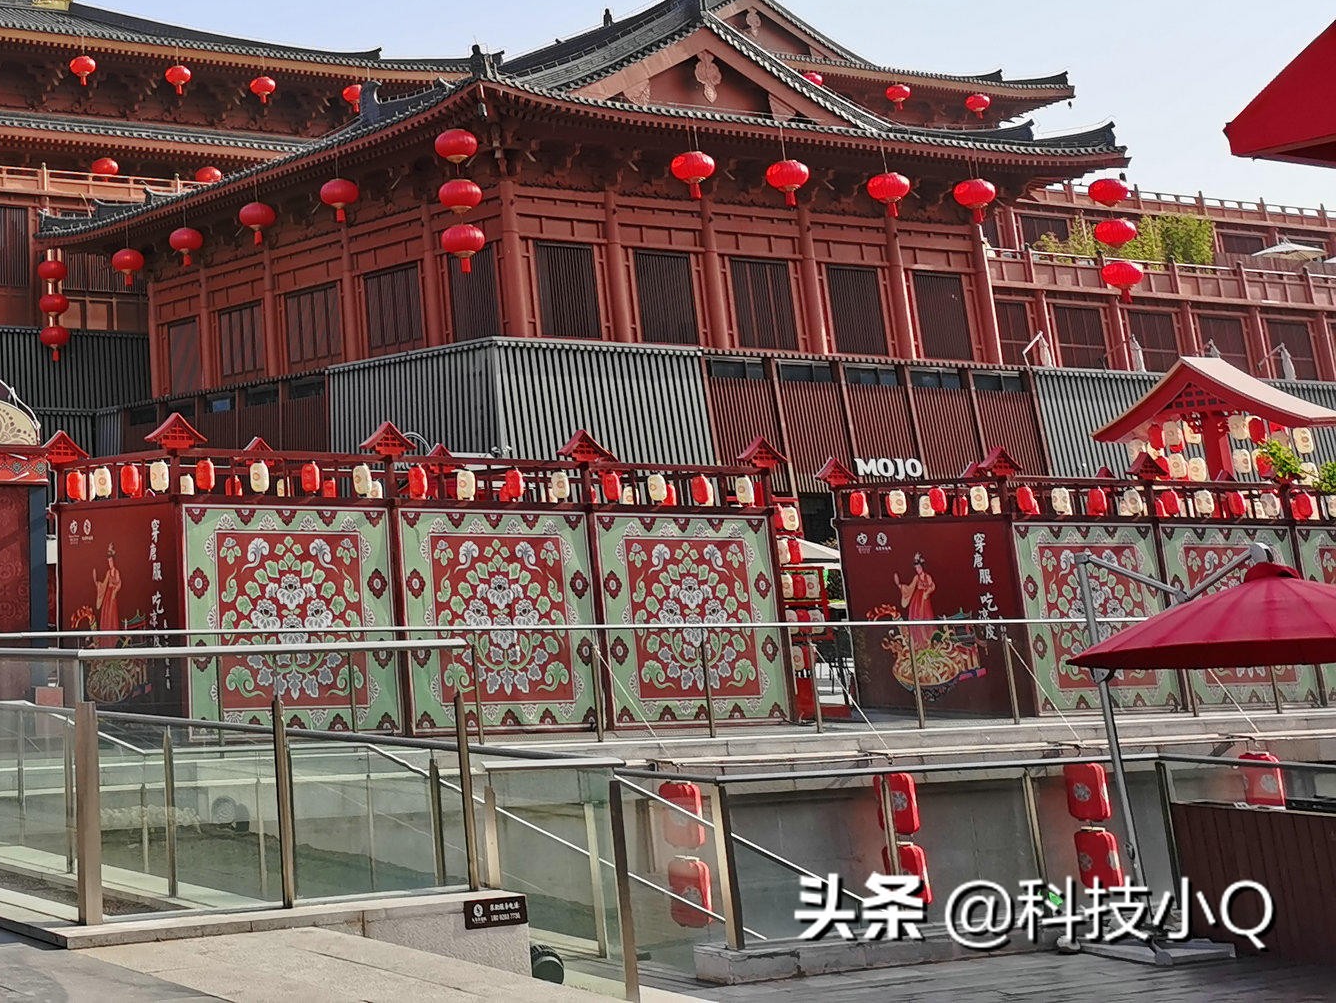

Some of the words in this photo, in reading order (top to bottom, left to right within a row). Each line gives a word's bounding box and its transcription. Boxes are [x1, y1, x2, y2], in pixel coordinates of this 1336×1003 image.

[854, 458, 923, 480] MOJO
[973, 533, 993, 585] 穿唐服
